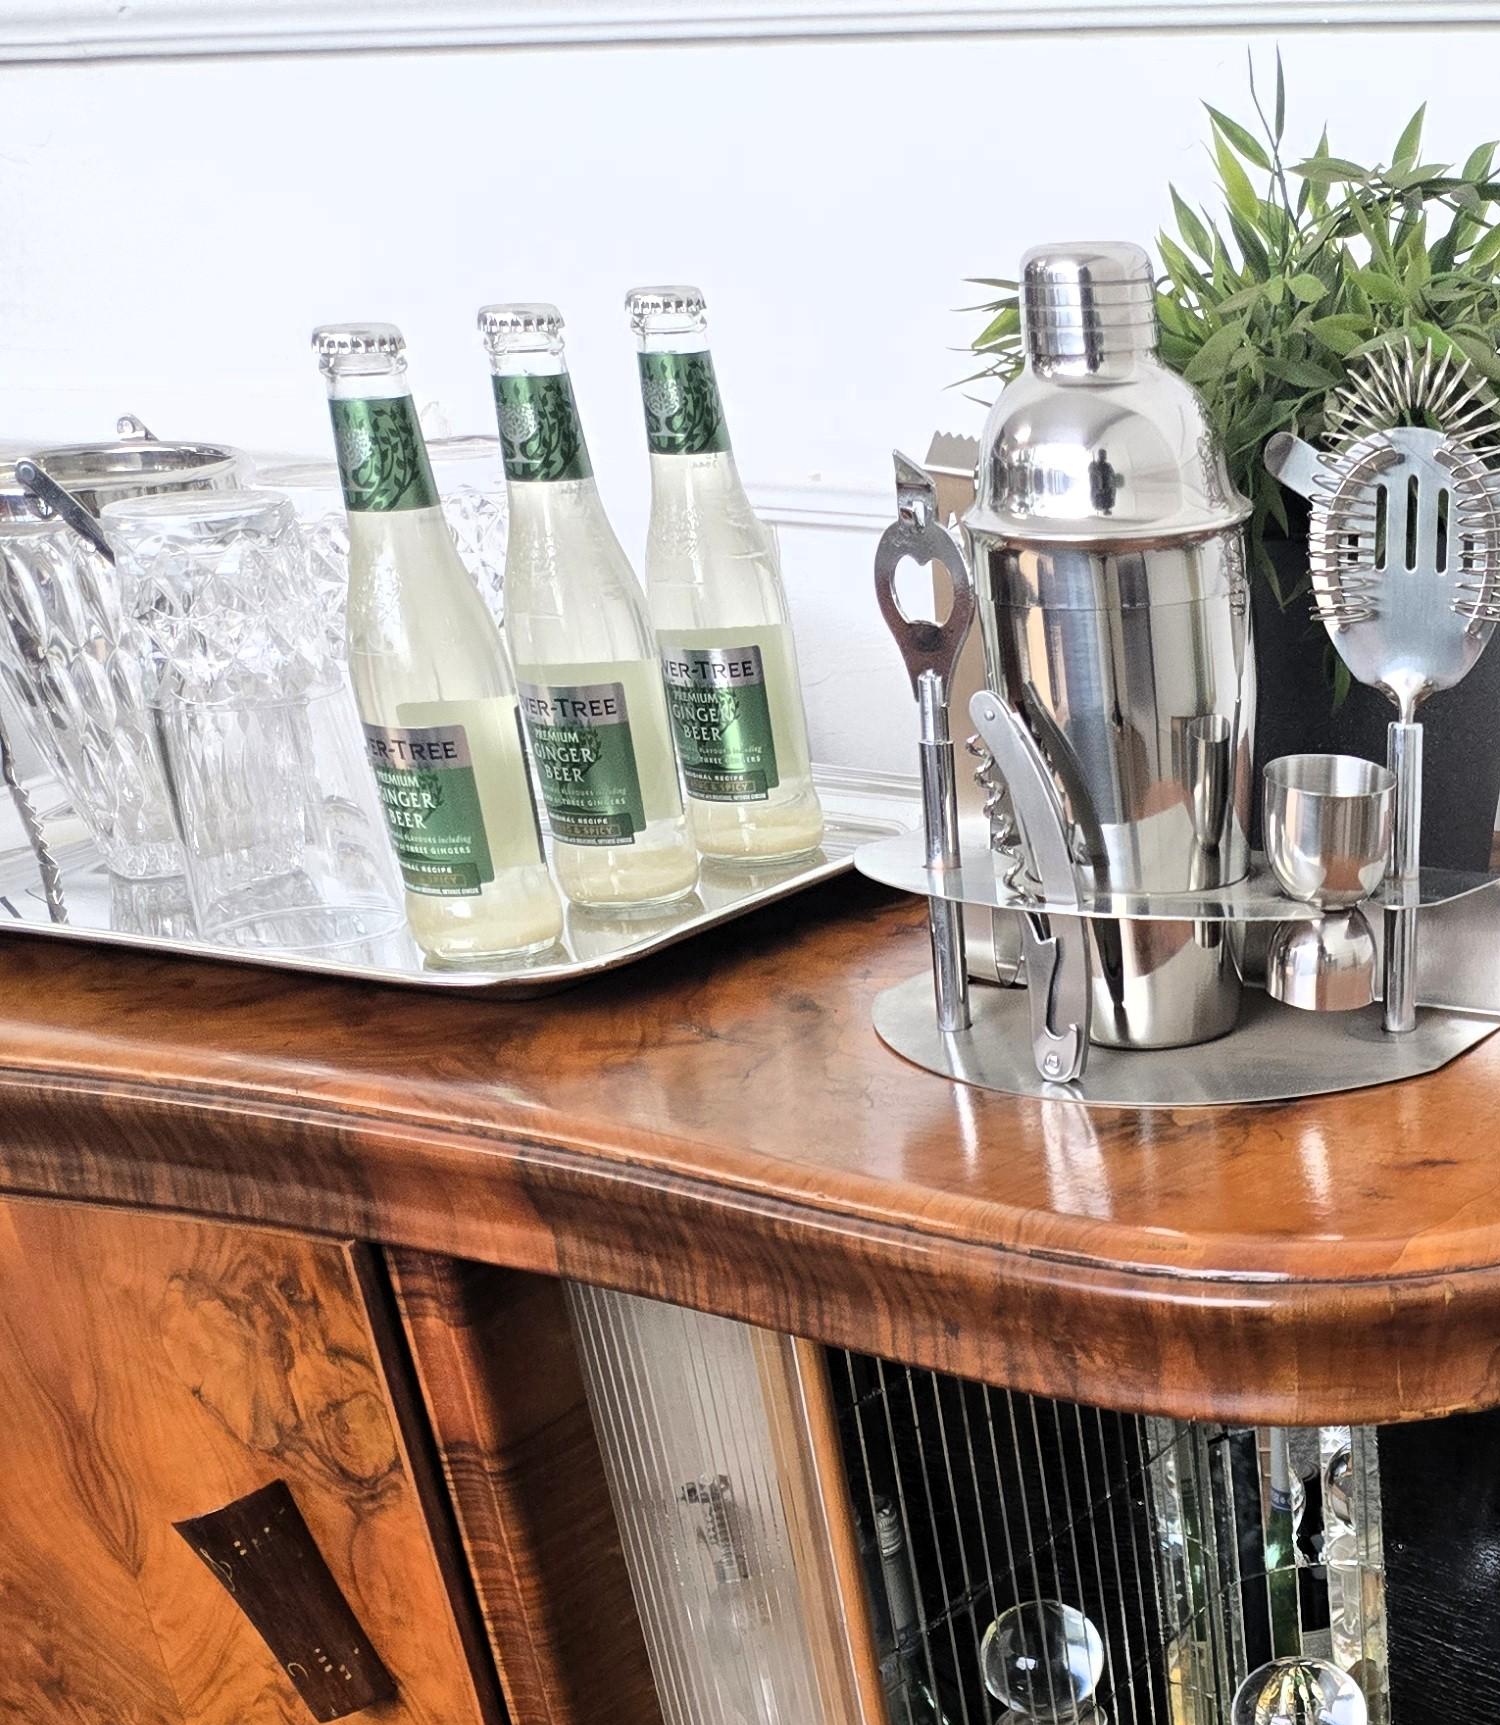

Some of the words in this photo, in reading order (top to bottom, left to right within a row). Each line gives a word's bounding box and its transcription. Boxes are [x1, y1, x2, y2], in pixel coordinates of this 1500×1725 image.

[683, 724, 722, 742] BEER
[533, 743, 594, 763] GINGER
[544, 764, 585, 783] BEER
[388, 809, 427, 830] BEER
[430, 845, 472, 855] GINGERS
